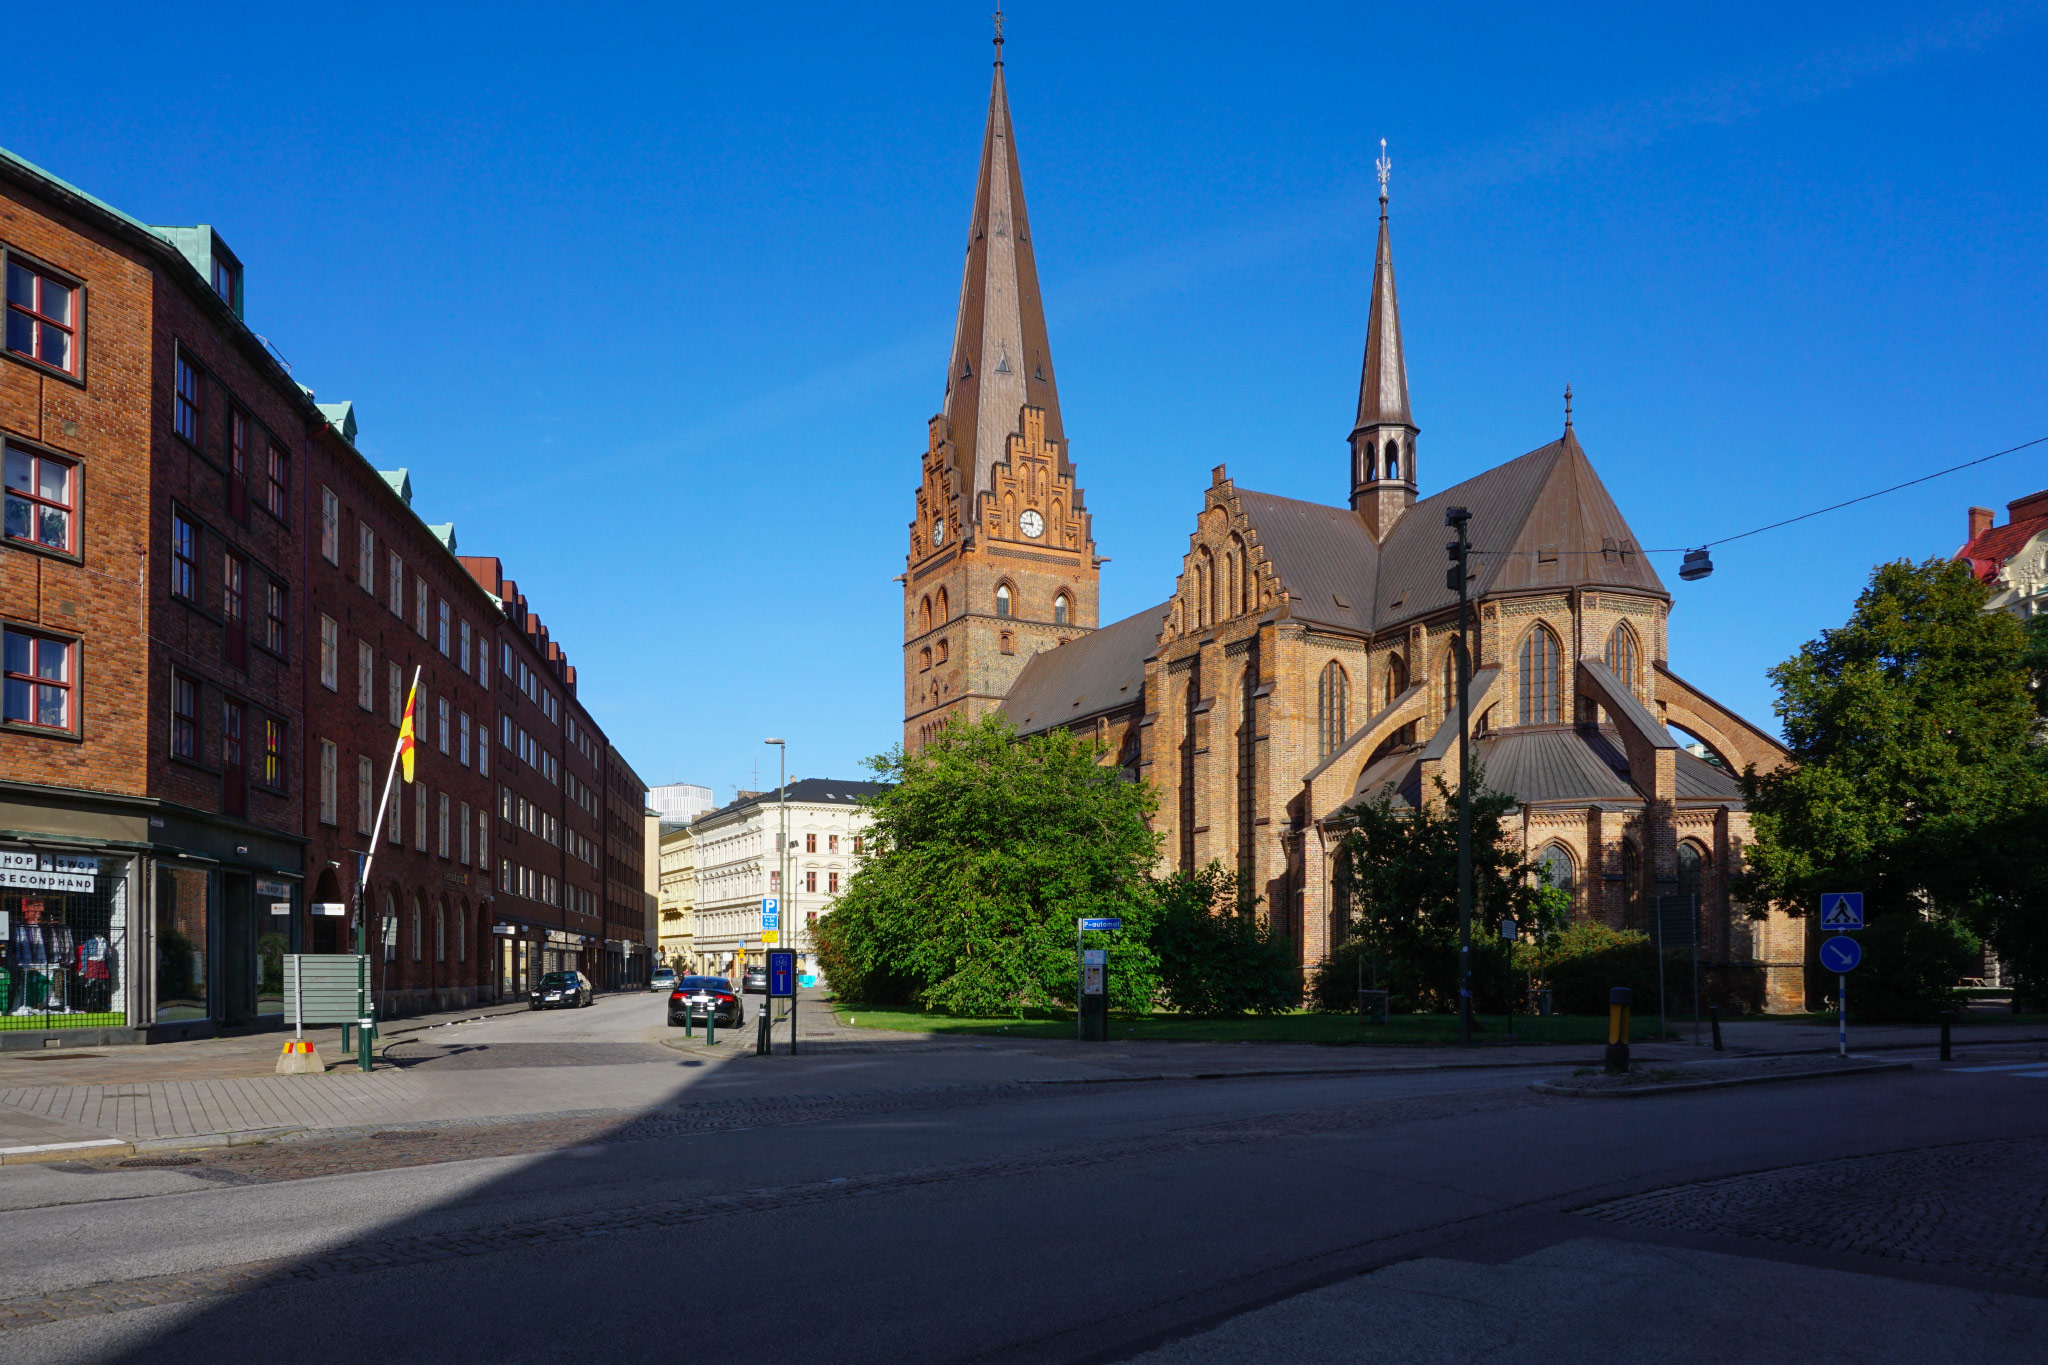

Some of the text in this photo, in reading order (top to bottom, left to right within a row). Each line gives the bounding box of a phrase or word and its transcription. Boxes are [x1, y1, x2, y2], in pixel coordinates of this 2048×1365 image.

[4, 855, 33, 865] HOP
[58, 860, 95, 869] SWOP
[0, 873, 91, 888] SECONDHAND
[765, 899, 775, 913] P
